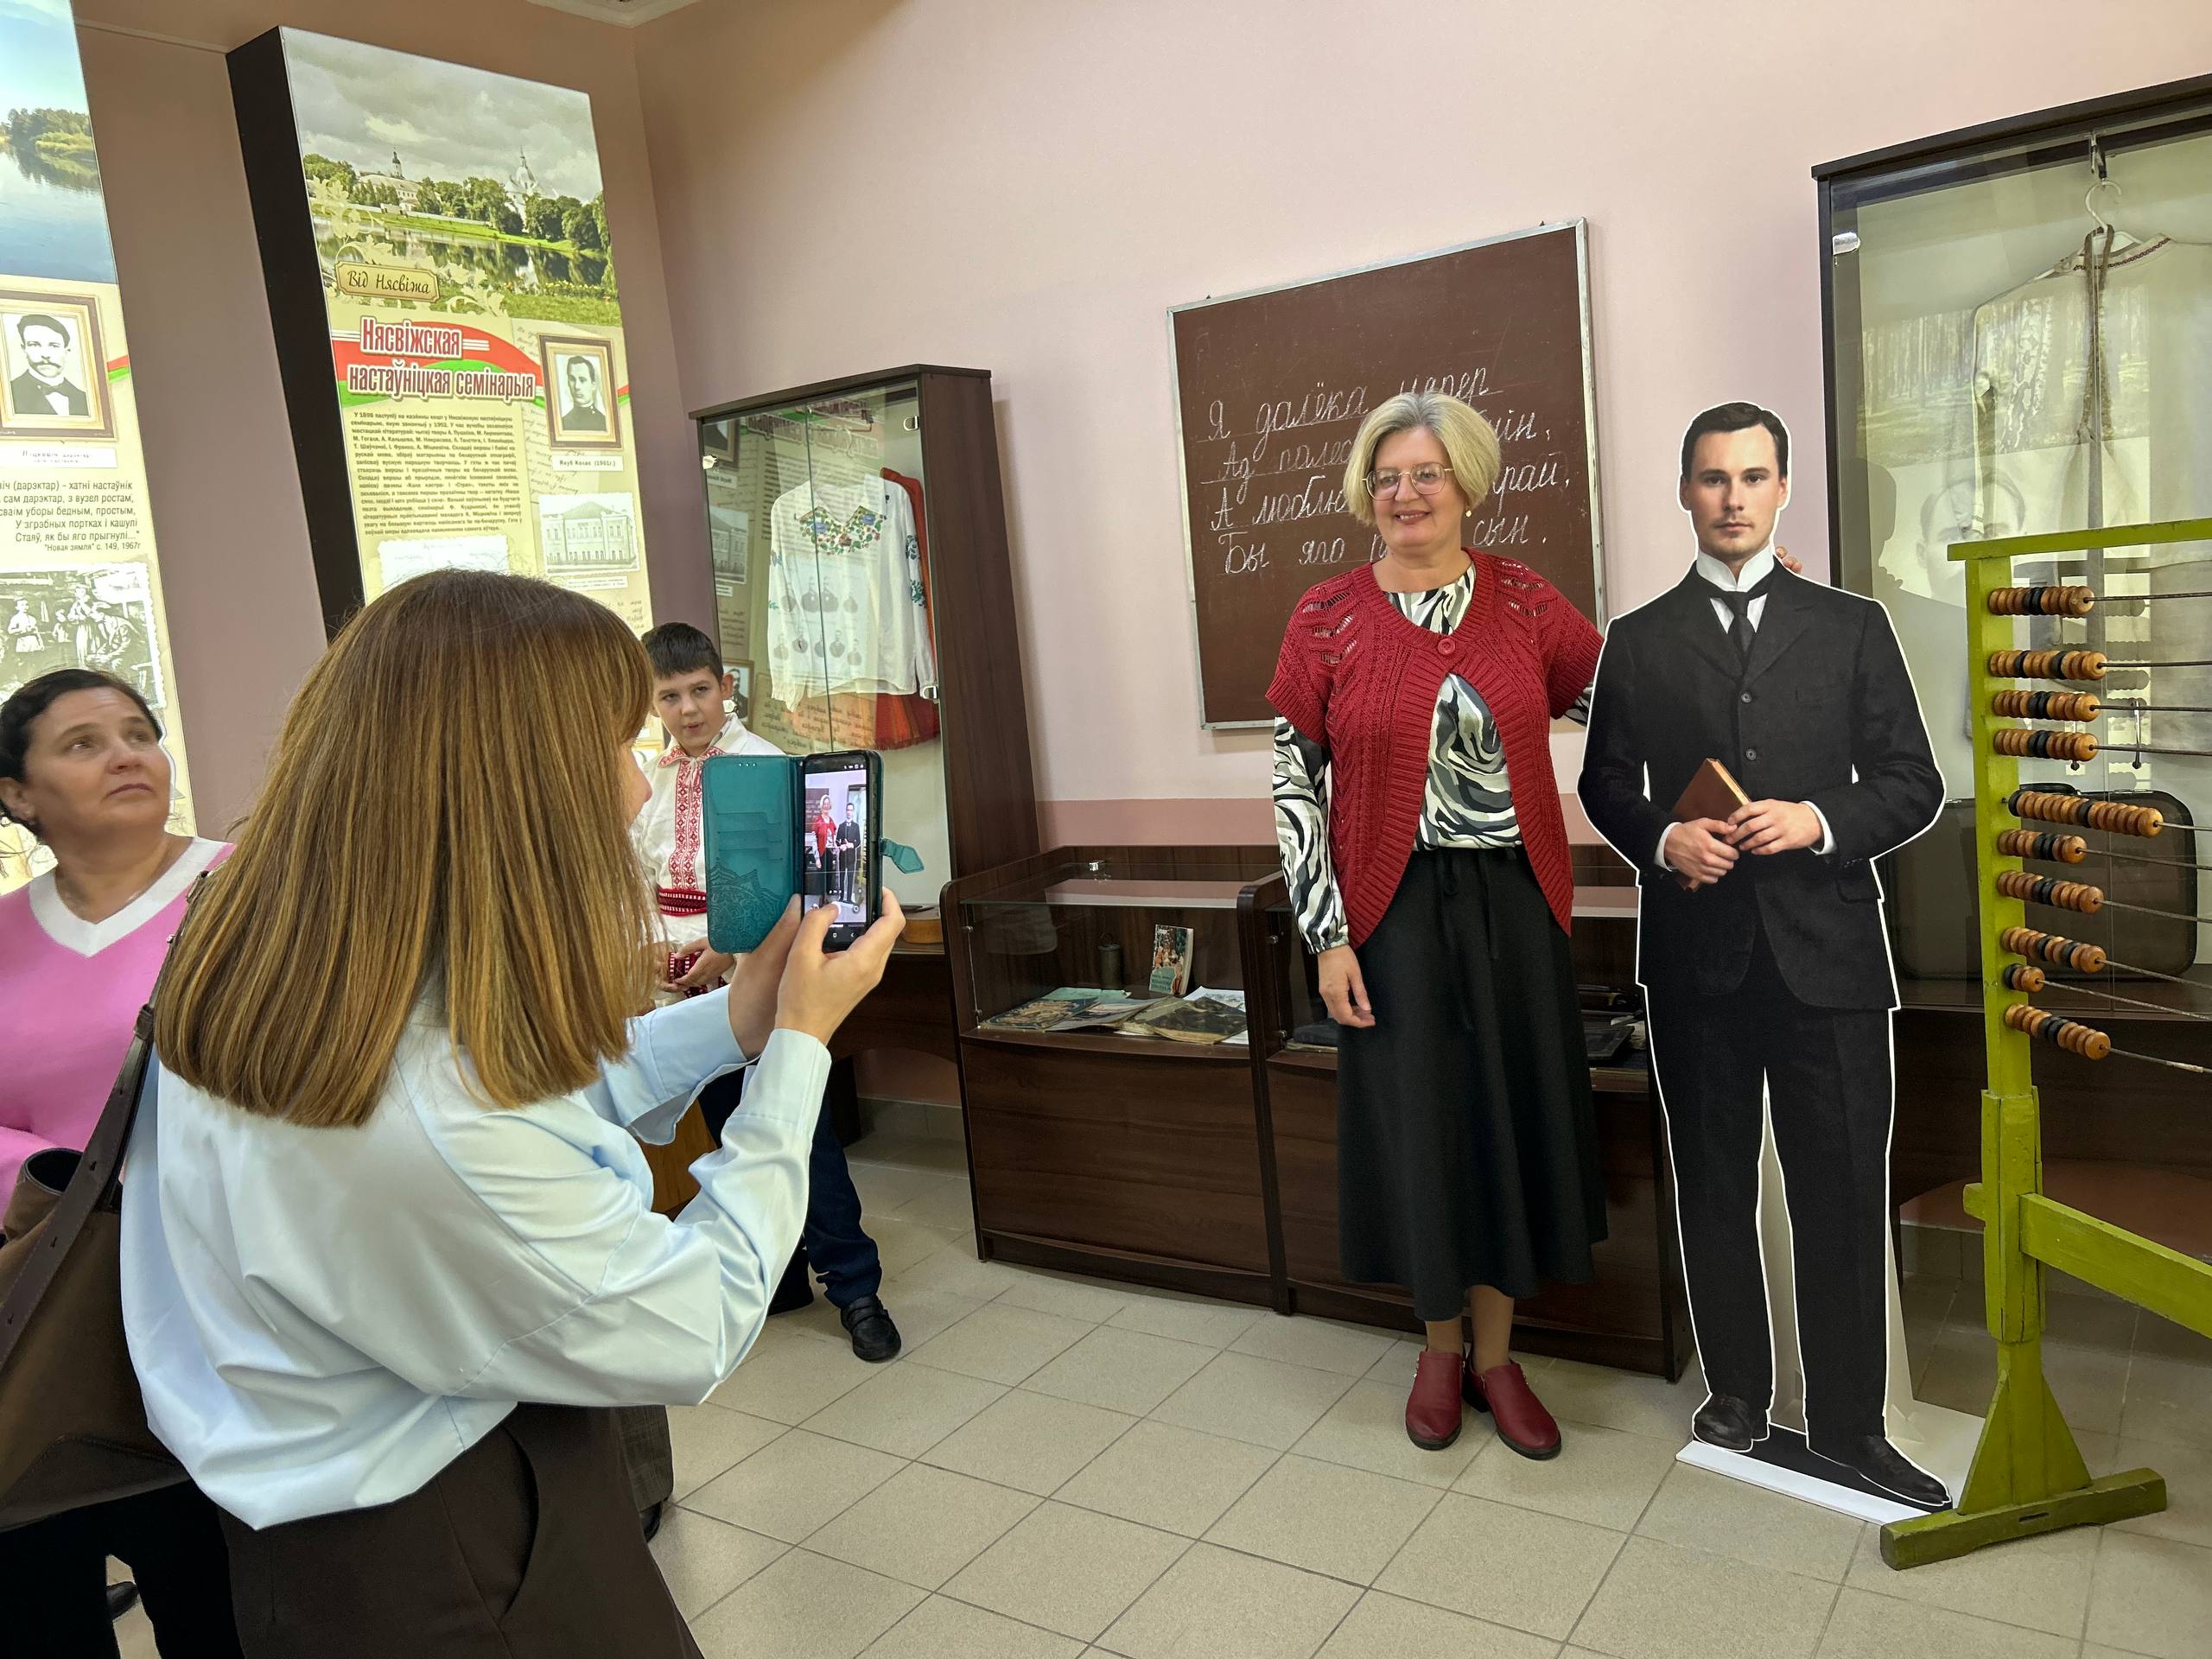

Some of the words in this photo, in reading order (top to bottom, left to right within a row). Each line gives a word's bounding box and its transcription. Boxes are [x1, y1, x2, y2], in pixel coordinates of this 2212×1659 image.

[347, 270, 369, 288] Від
[376, 274, 431, 294] Нясвіжа
[363, 319, 460, 356] Нясвіжская
[349, 359, 450, 397] настаўніцкая
[455, 368, 534, 401] семінарыя
[1208, 400, 1231, 440] Я
[1253, 380, 1369, 462] далёка
[13, 480, 60, 492] (дарэктар)
[69, 480, 90, 490] хатні
[92, 480, 132, 492] настаўнік
[23, 495, 65, 504] дарэктар,
[75, 495, 99, 505] вузел
[101, 495, 134, 504] ростам,
[26, 506, 54, 518] уборы
[56, 506, 92, 517] бедным,
[96, 507, 136, 517] простым,
[1211, 487, 1234, 531] А
[16, 520, 22, 529] У
[24, 519, 66, 529] згрэбных
[68, 519, 102, 529] портках
[110, 518, 137, 529] кашулі
[16, 532, 41, 543] Стаяў,
[57, 532, 69, 542] бы
[1218, 531, 1270, 575] Бы
[1299, 537, 1345, 565] яго
